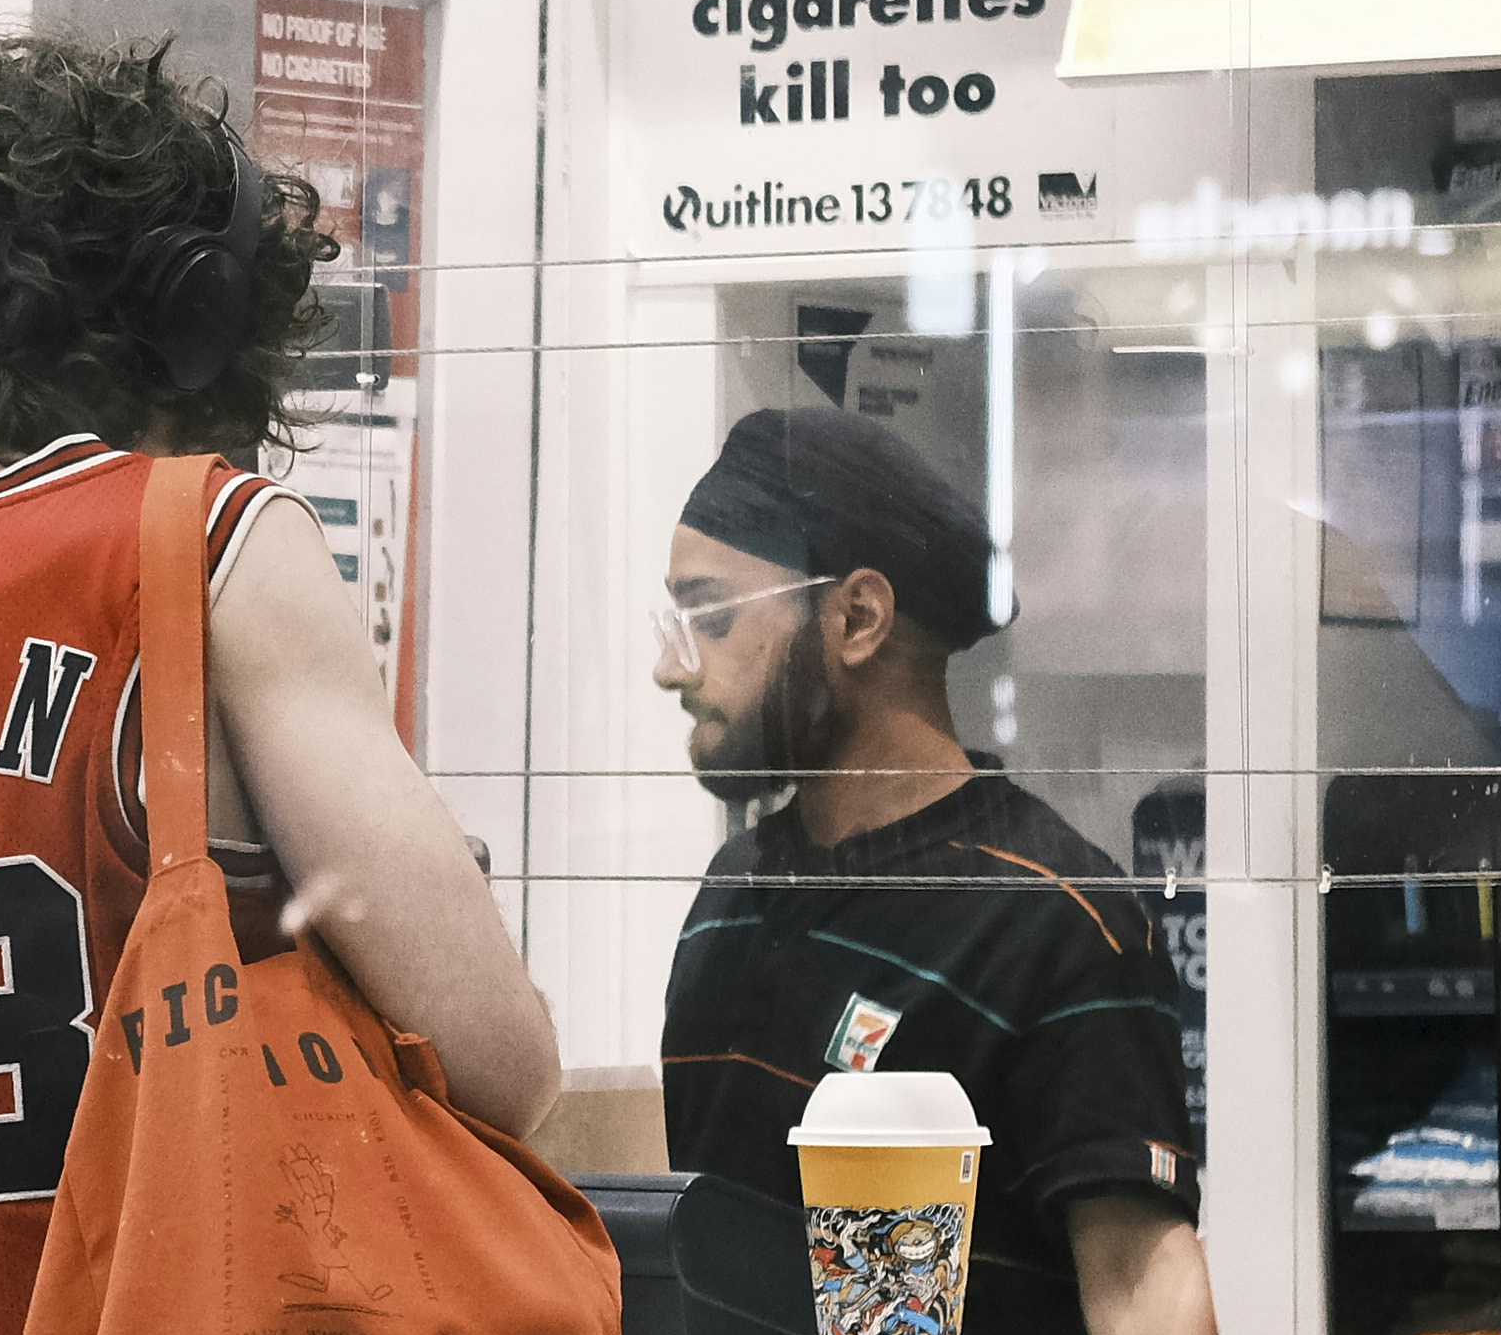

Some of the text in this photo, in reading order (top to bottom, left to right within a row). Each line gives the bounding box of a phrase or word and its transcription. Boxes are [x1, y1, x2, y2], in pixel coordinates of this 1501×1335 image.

[261, 12, 284, 40] NO
[285, 15, 335, 44] PROOF
[335, 21, 356, 47] OF
[261, 51, 372, 89] NO CIGARETTES
[739, 59, 997, 125] kill too
[663, 180, 841, 232] Quitline
